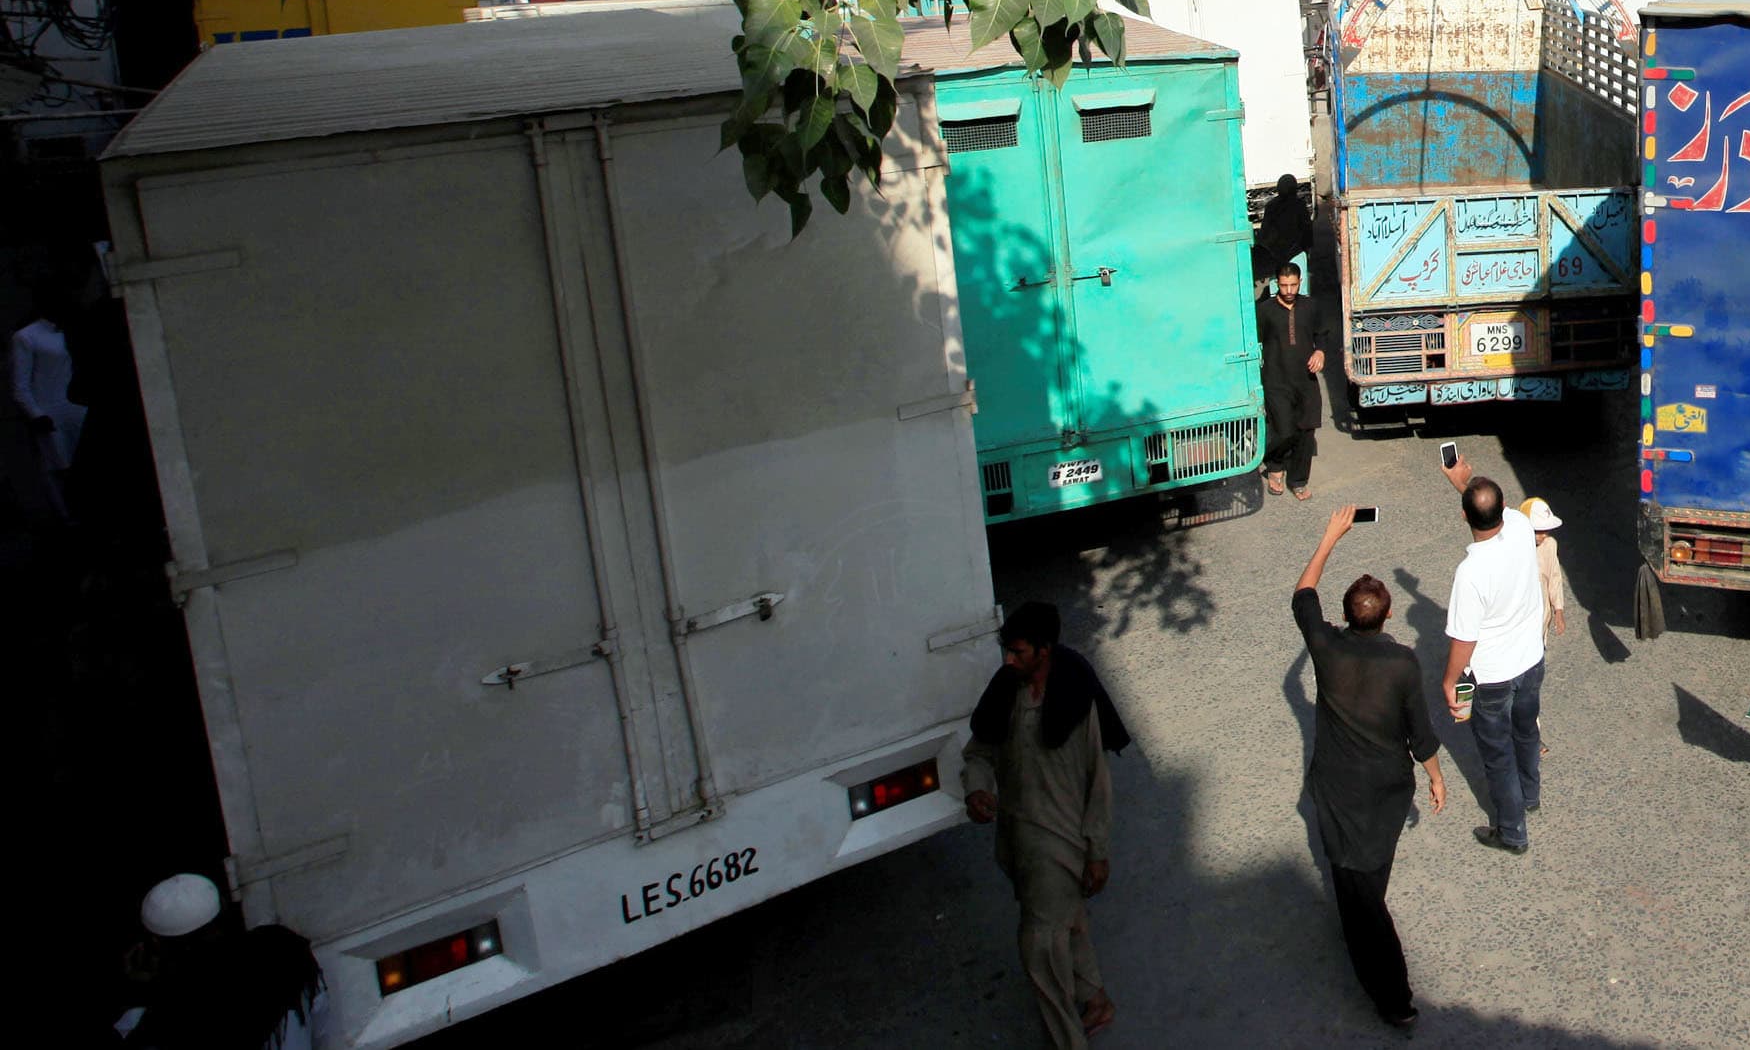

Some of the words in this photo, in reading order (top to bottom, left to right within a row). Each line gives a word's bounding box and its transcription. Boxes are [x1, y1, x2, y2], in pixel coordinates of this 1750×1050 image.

[1399, 248, 1440, 291] گروپ
[1558, 256, 1583, 278] 69
[1487, 324, 1509, 335] MNS
[1476, 335, 1522, 354] 6299
[1065, 464, 1099, 478] 2449
